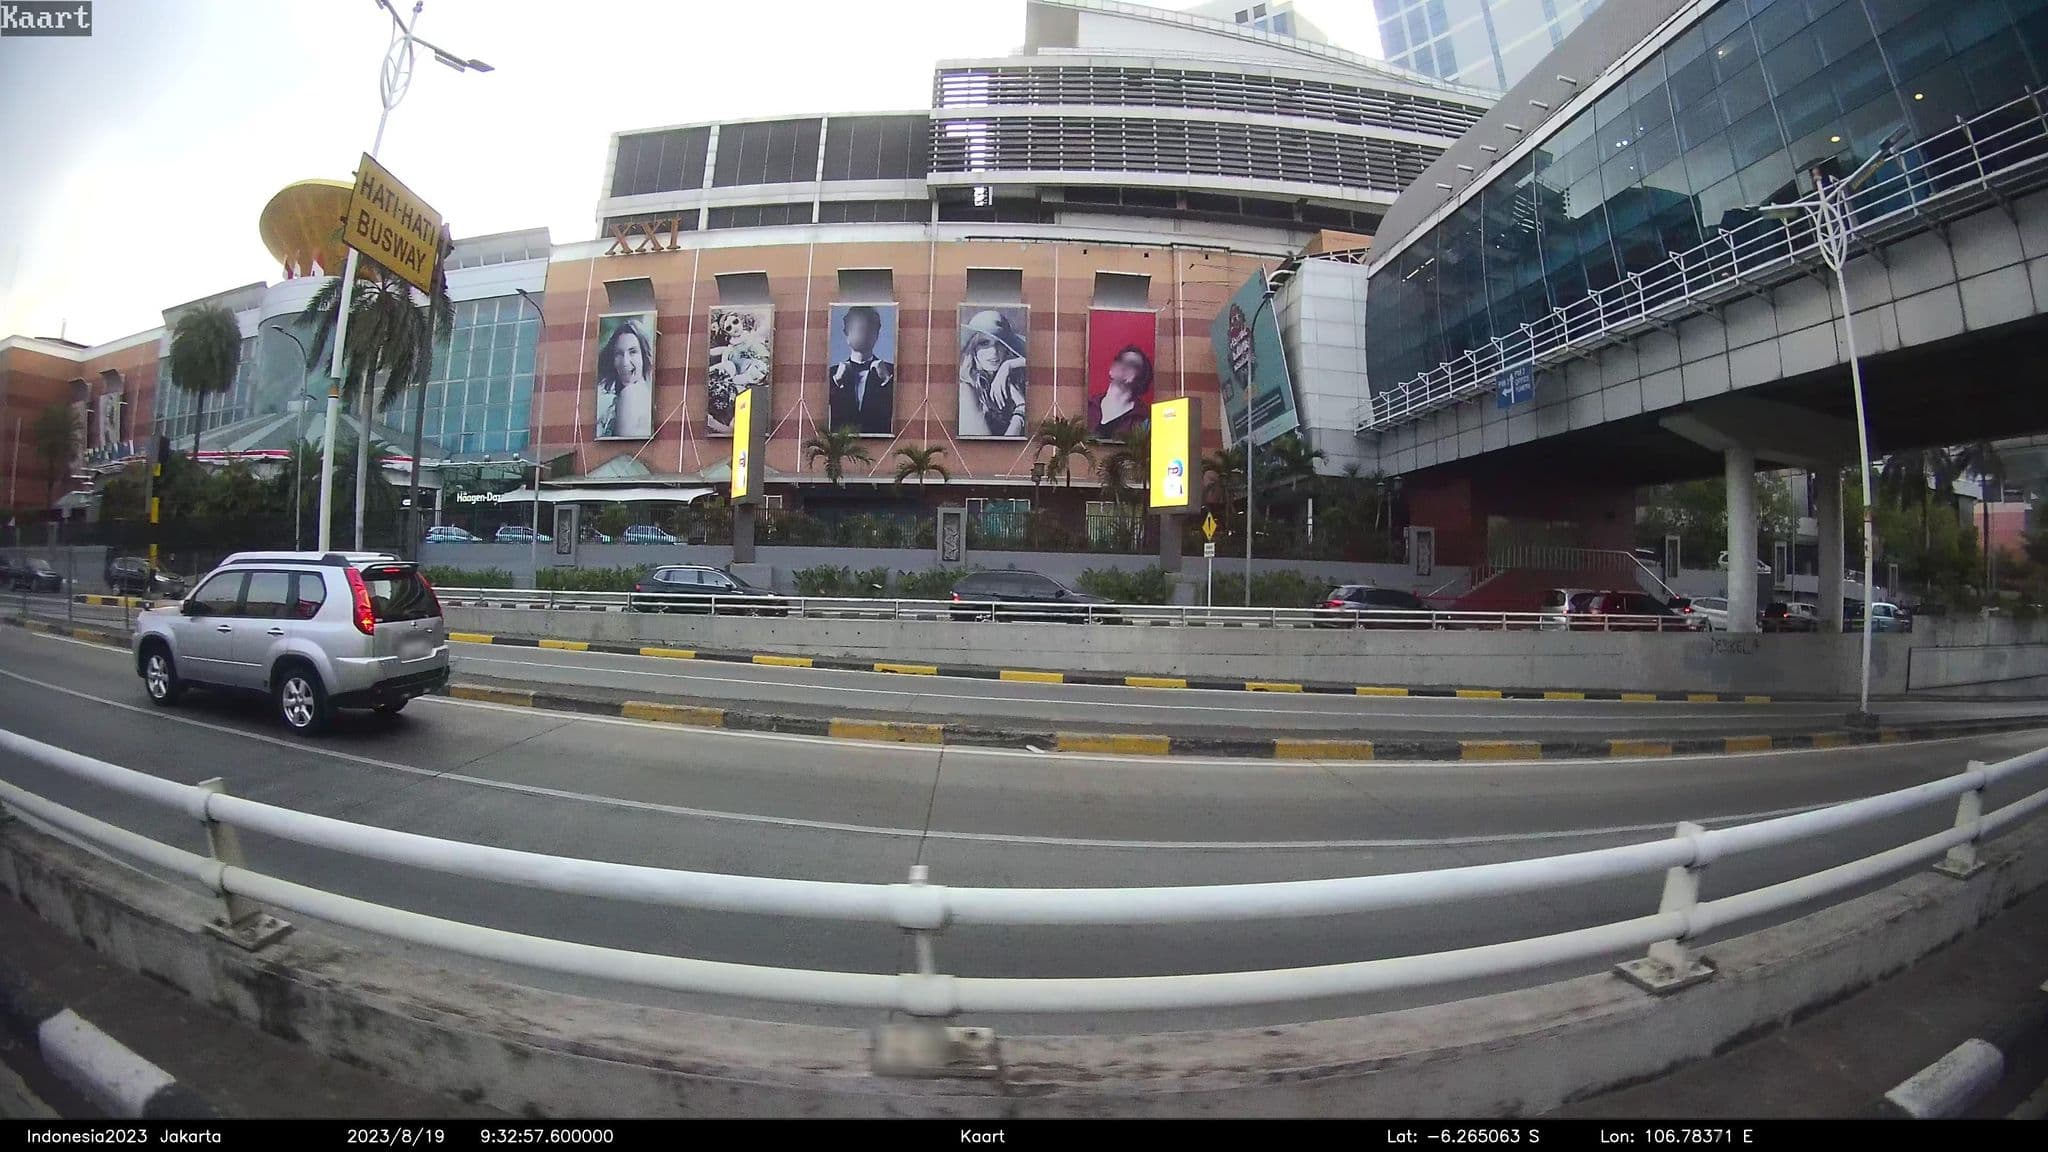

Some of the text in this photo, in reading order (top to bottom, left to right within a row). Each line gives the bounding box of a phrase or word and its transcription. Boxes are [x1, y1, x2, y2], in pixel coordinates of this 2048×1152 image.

[357, 208, 426, 274] BUSWAY
[360, 171, 436, 246] HATI-HATI
[604, 216, 683, 256] XXI
